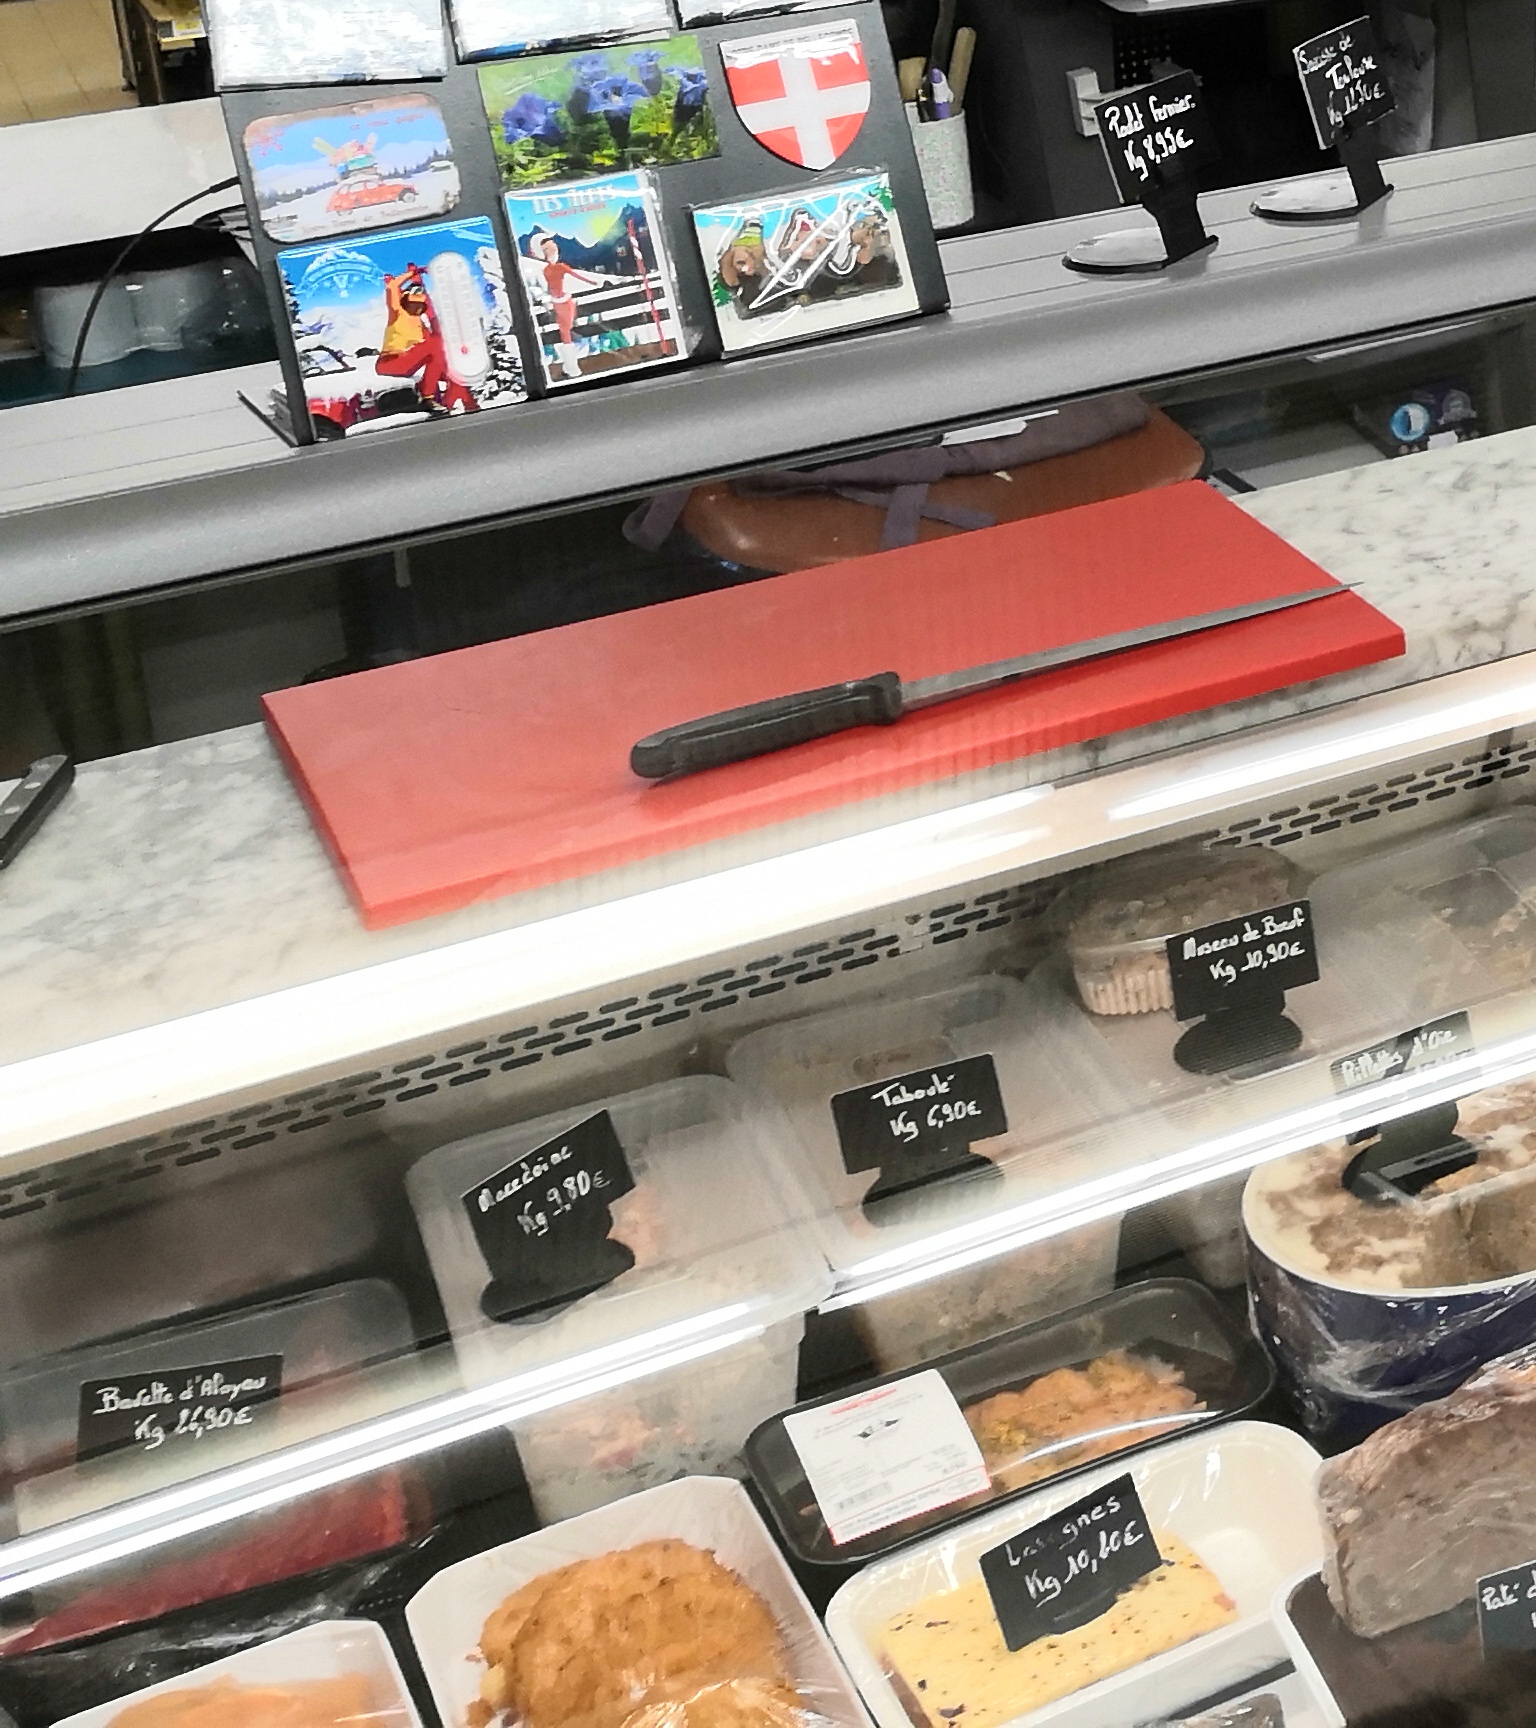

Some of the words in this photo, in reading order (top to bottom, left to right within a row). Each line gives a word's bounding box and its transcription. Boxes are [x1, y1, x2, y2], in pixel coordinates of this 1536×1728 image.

[1103, 101, 1146, 140] Poulet
[1123, 139, 1149, 182] Kg
[1183, 930, 1241, 962] Museau
[1242, 921, 1264, 944] de
[1209, 957, 1237, 985] Kg
[1240, 939, 1305, 974] 10,90€
[871, 1072, 957, 1108] Taboulé
[889, 1116, 919, 1143] Kg
[926, 1098, 983, 1131] 6,90€
[516, 1199, 550, 1237] Kg
[133, 1412, 166, 1451] Kg
[1025, 1569, 1063, 1610] Kg
